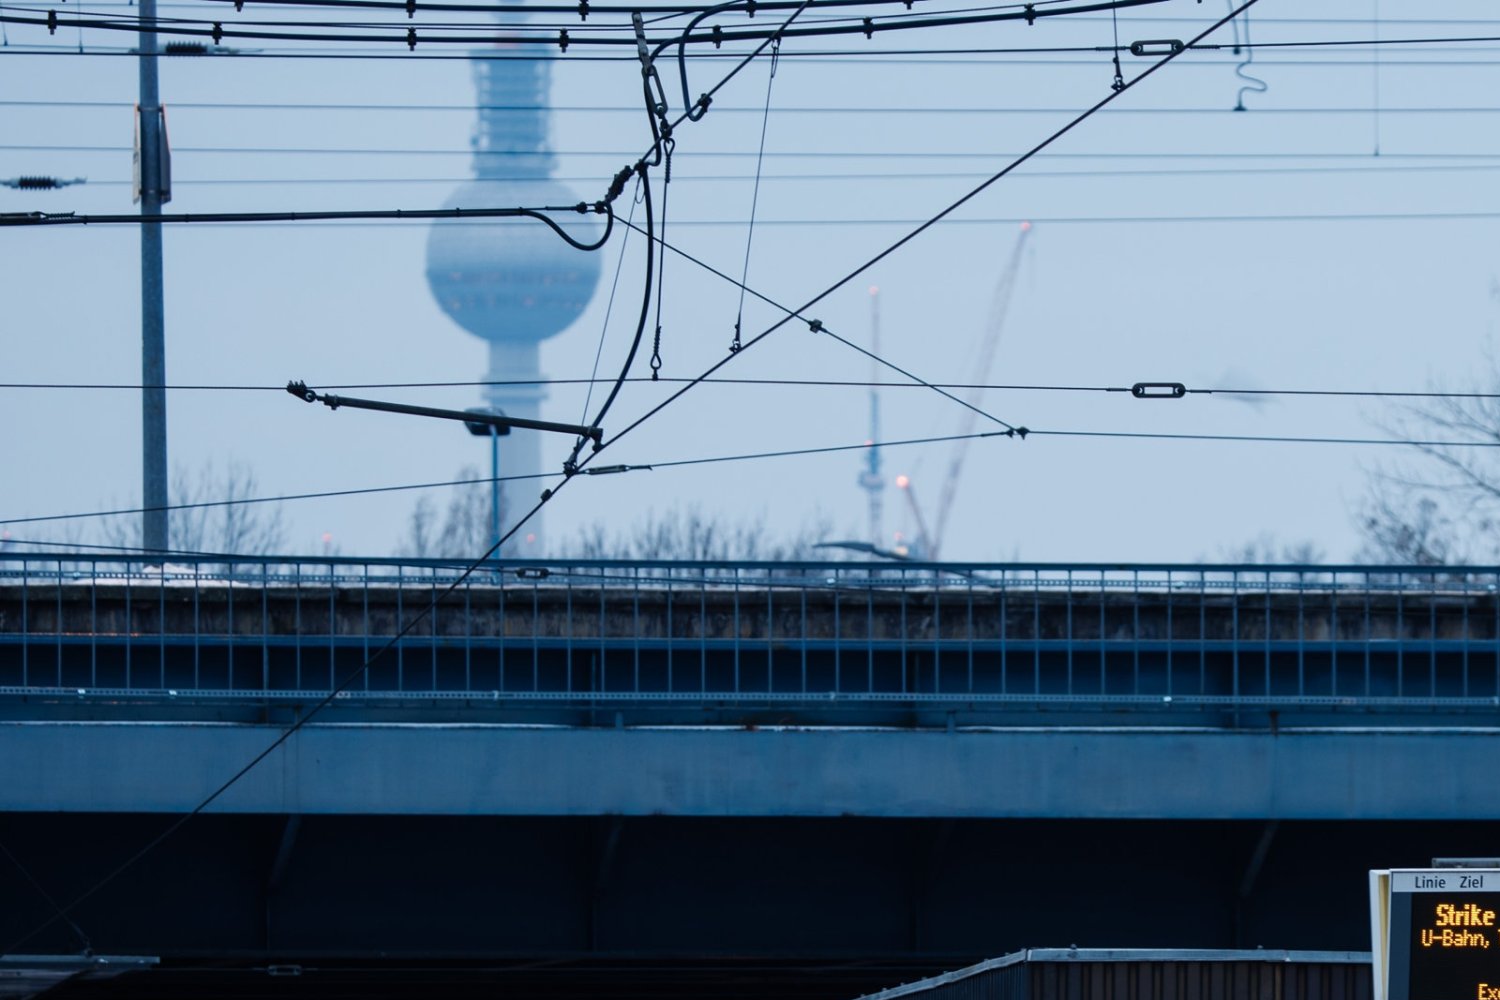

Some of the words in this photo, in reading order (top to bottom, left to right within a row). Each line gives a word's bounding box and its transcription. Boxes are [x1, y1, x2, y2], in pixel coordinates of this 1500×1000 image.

[1415, 875, 1447, 889] Linie
[1459, 875, 1484, 889] Ziel
[1436, 904, 1495, 926] Strike
[1421, 929, 1490, 948] U-Bahn,
